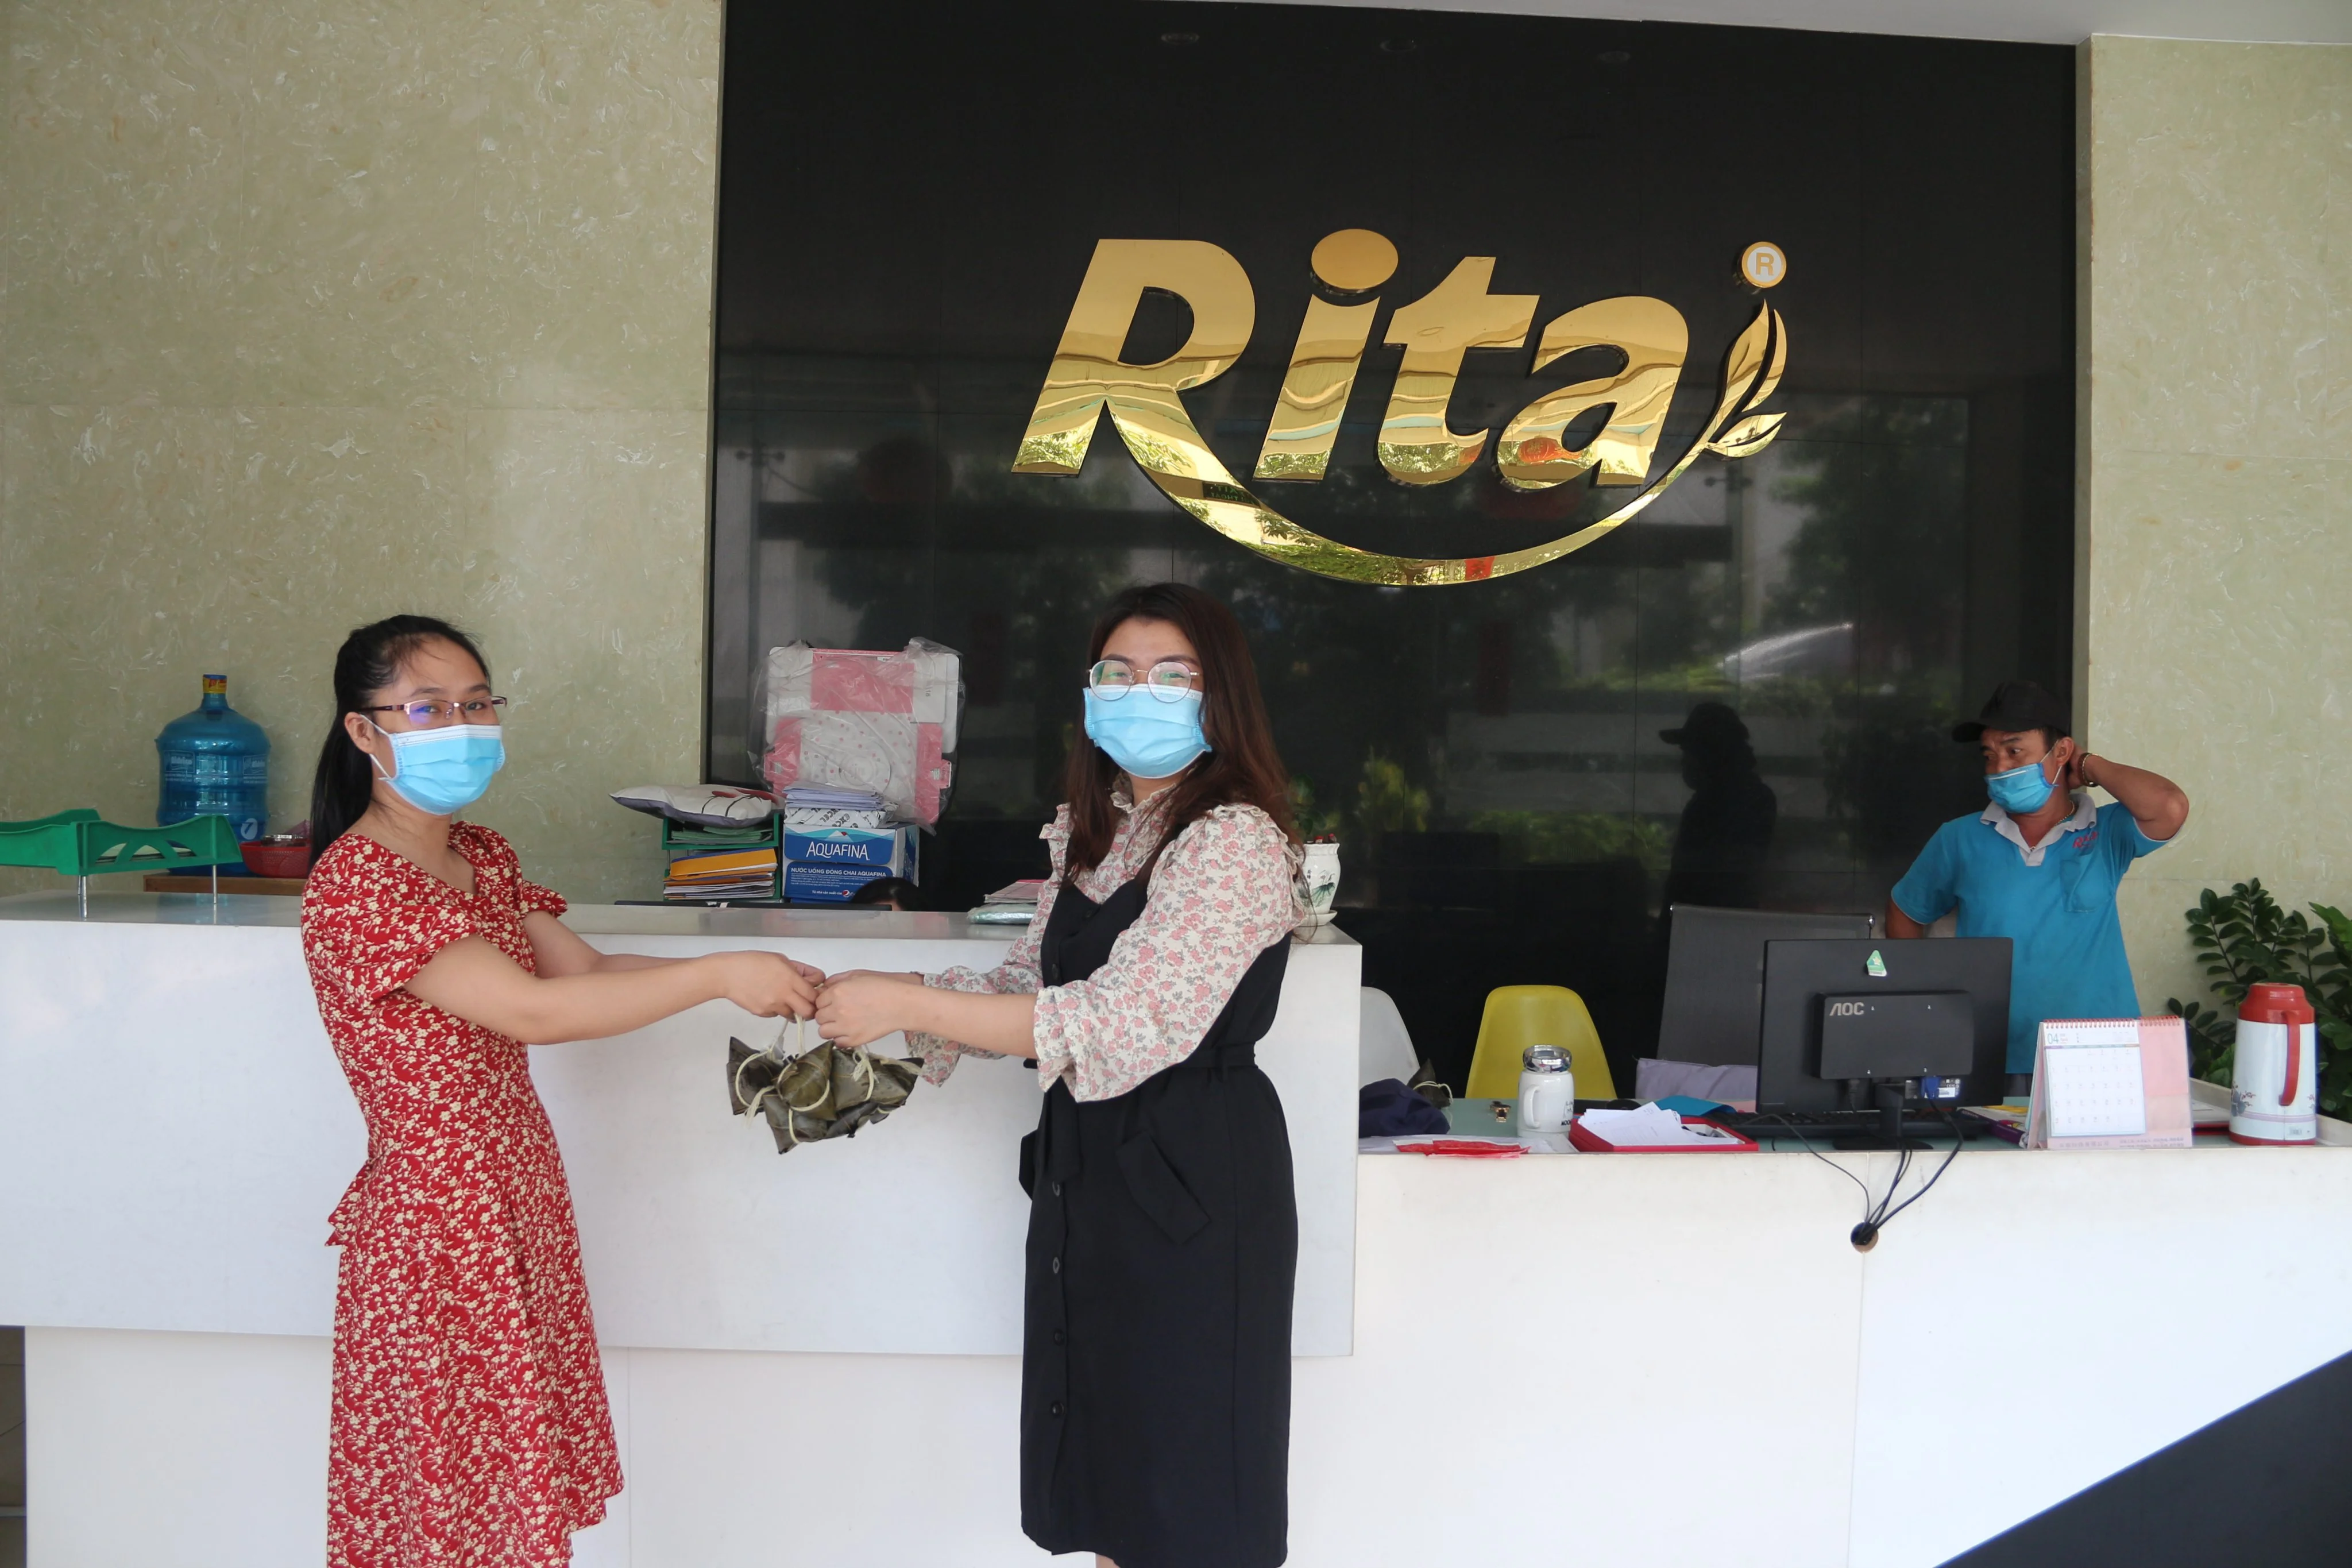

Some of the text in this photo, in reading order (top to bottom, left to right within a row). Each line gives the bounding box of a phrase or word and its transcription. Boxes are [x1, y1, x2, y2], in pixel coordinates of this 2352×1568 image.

[1011, 228, 1691, 586] Rita
[820, 808, 841, 822] XCEL
[806, 841, 870, 861] AQUAFINA
[1829, 1002, 1864, 1016] AOC
[2047, 1033, 2059, 1044] 04
